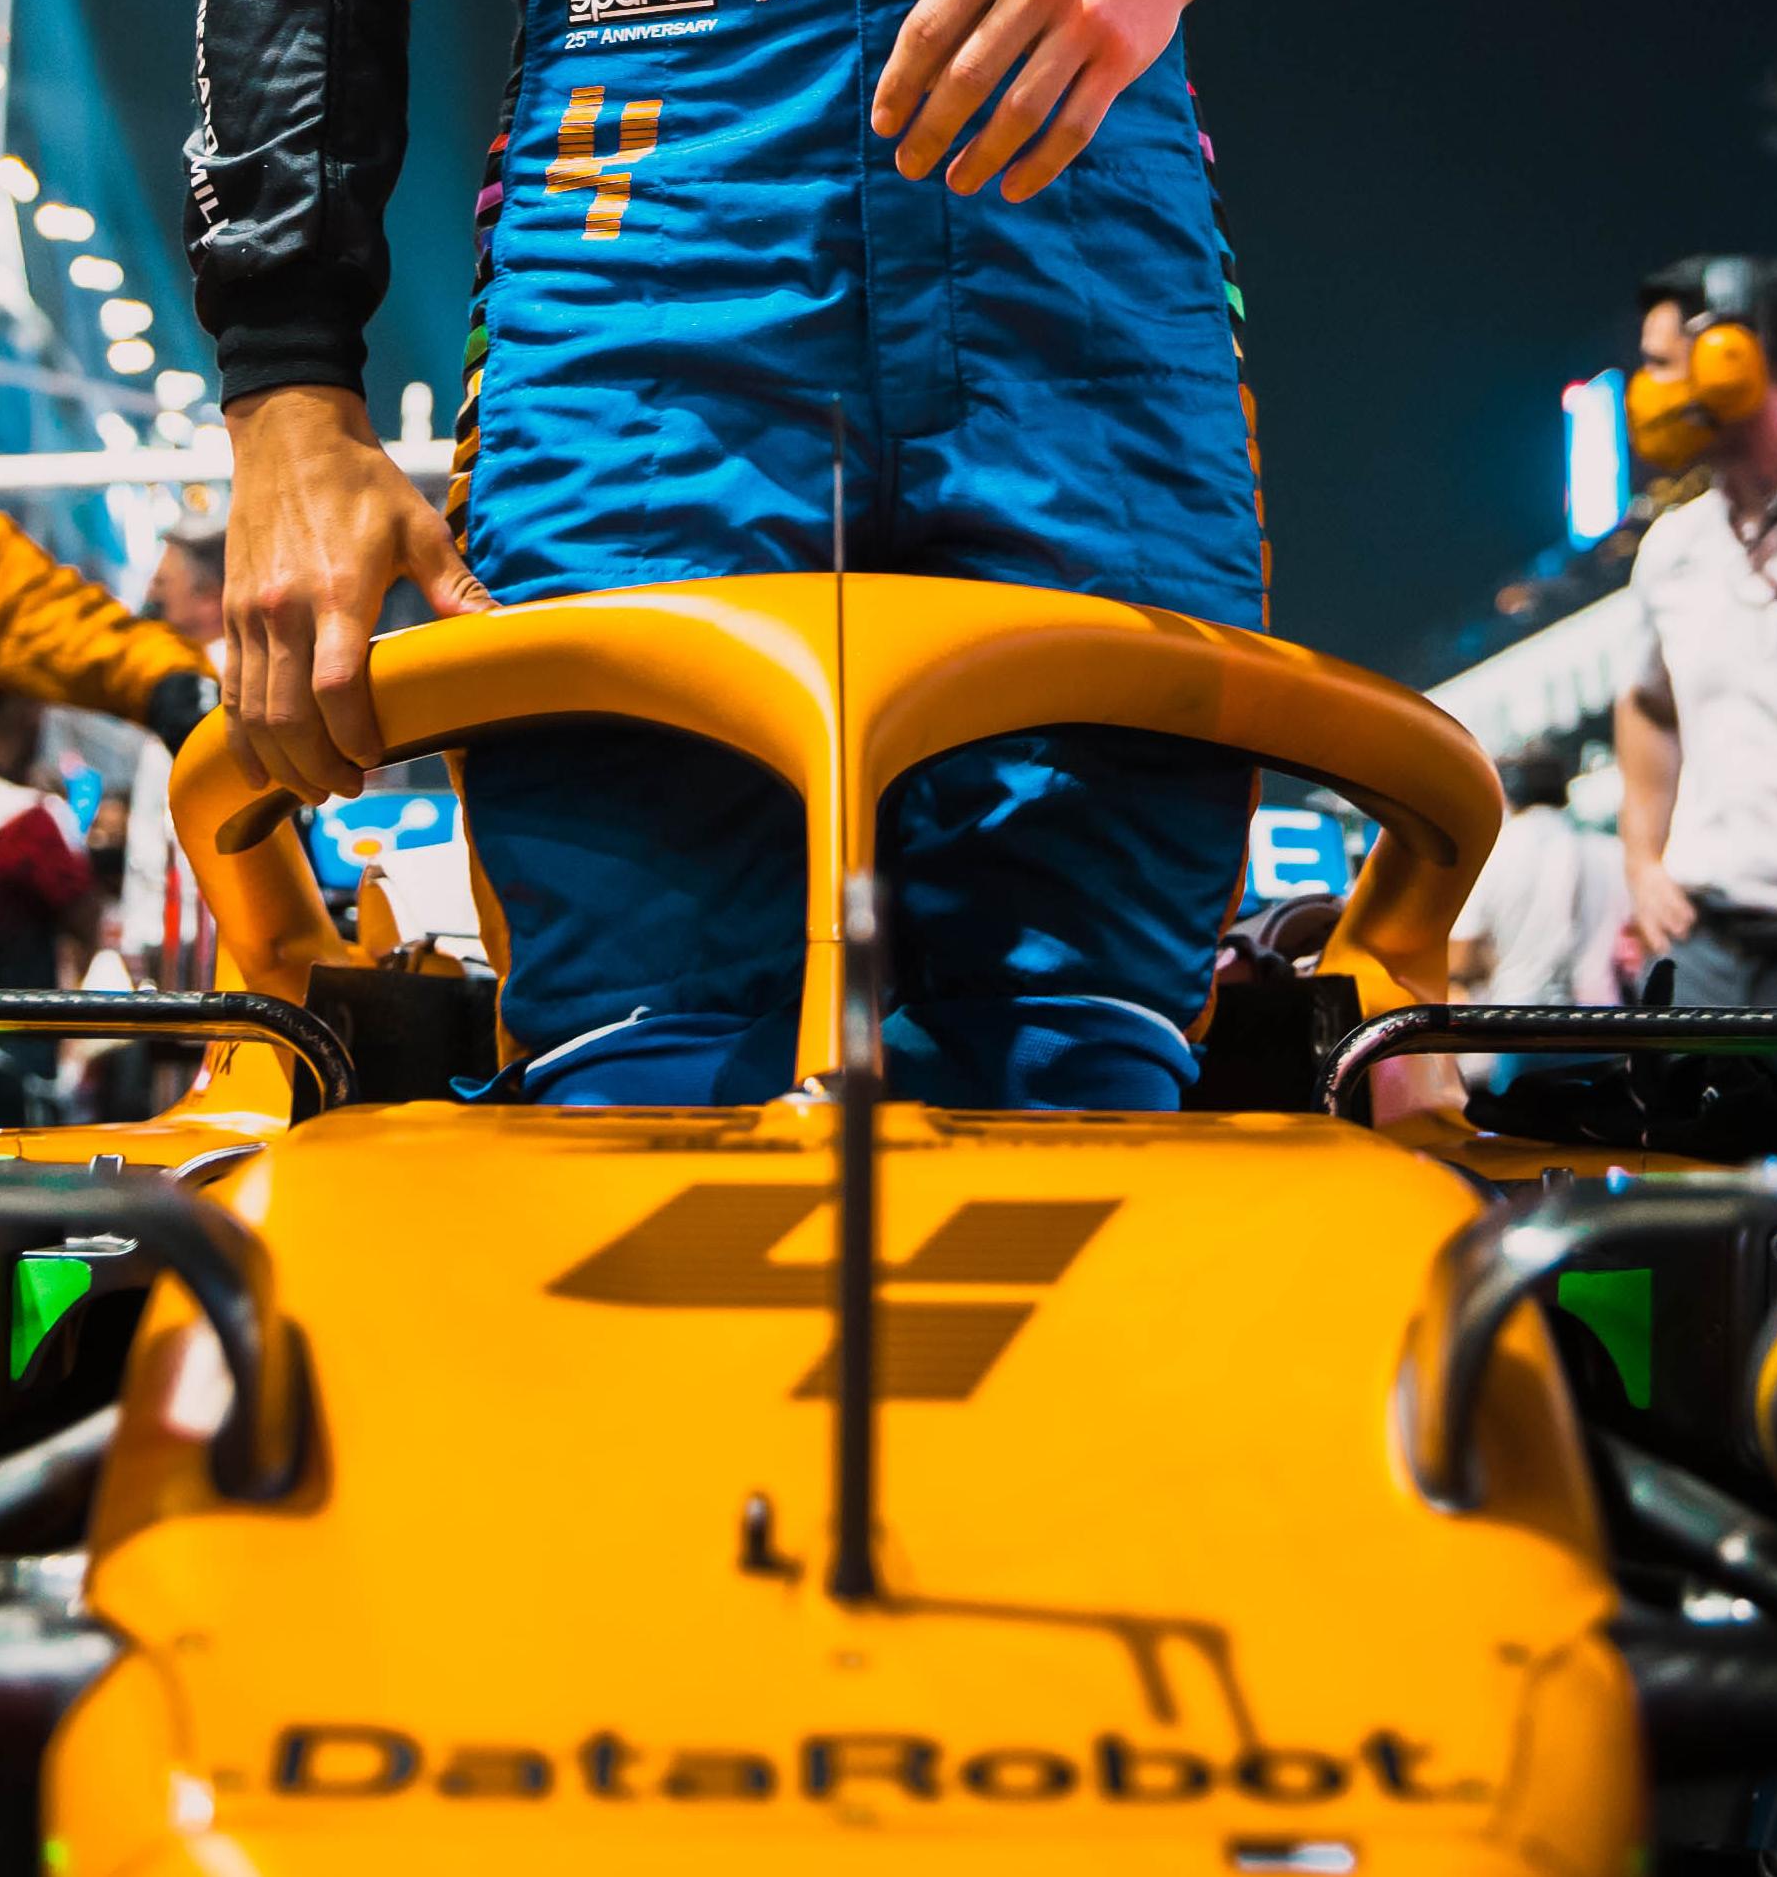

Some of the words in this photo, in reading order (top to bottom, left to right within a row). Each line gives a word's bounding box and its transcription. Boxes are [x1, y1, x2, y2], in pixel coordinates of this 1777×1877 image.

[600, 18, 719, 45] ANNIVERSARY
[544, 85, 663, 240] 4
[547, 1183, 1127, 1400] 4
[268, 1723, 1435, 1804] DataRobot
